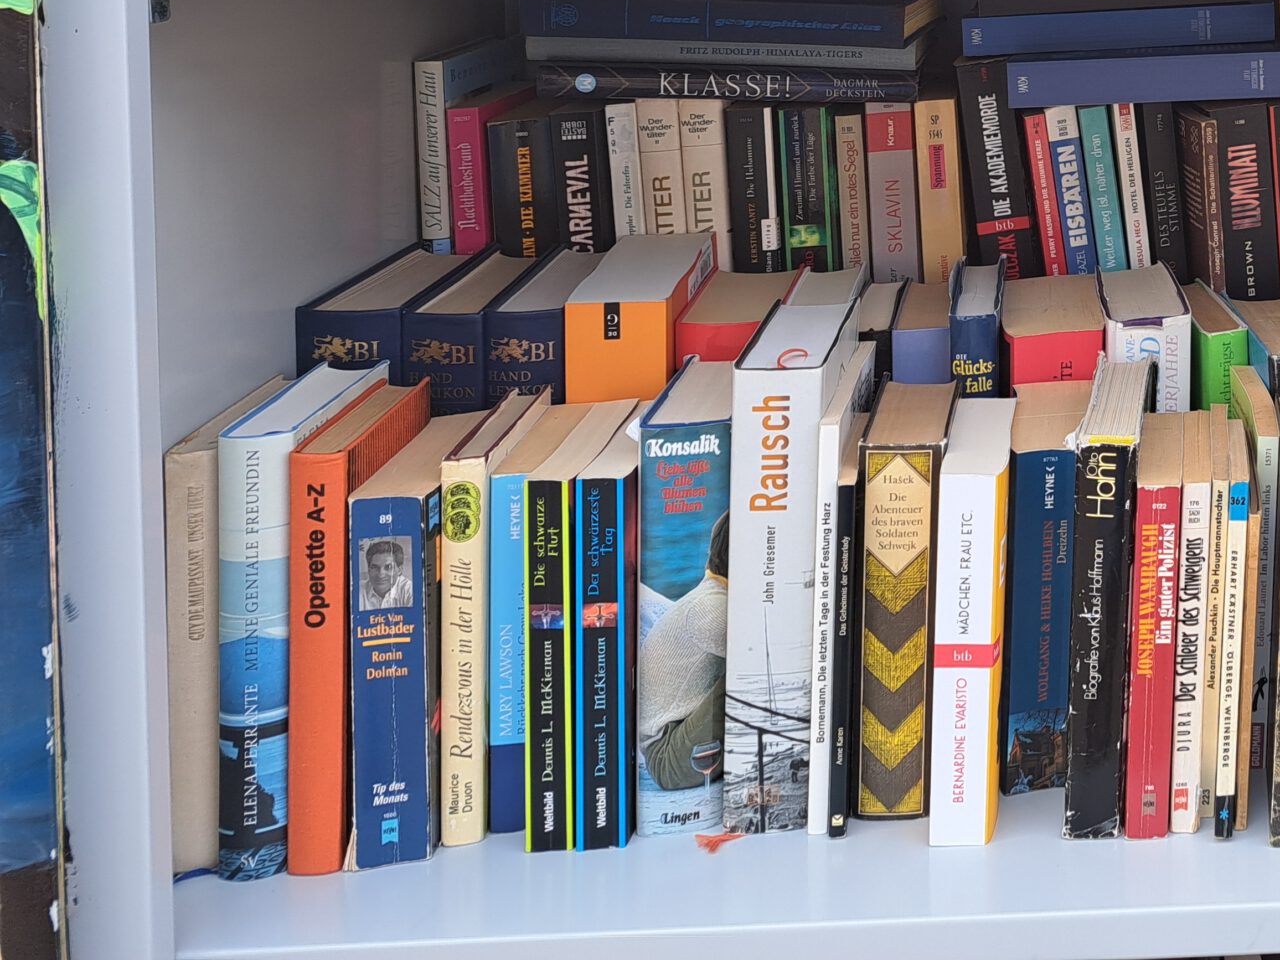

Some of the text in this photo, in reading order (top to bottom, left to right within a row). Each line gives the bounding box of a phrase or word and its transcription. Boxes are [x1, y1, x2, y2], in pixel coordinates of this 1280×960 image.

[659, 73, 791, 98] KLASSE!
[825, 88, 885, 98] DECKSTEIN
[833, 79, 879, 88] DAGMAR
[1063, 145, 1085, 247] EISBÄREN
[1245, 240, 1255, 297] BROWN
[952, 359, 996, 379] Glücks-
[966, 375, 993, 393] falle
[749, 394, 791, 512] Rausch
[1086, 452, 1098, 477] Otto
[1086, 452, 1116, 518] Hahn
[244, 450, 260, 671] MEINE GENIALE FREUNDIN
[304, 483, 329, 629] Operette A-Z
[762, 525, 776, 605] John Griesemer
[956, 510, 973, 634] MÄDCHEN, FRAU ETC.
[449, 559, 473, 759] Rendezvous in der Hölle
[541, 640, 554, 781] Dennis L. McKiernan
[953, 677, 968, 802] BERNARDINE EVARISTO
[243, 683, 259, 826] ELENA FERRANTE
[448, 774, 460, 815] Maurice
[462, 781, 473, 813] Druon
[543, 791, 554, 832] Weltbild
